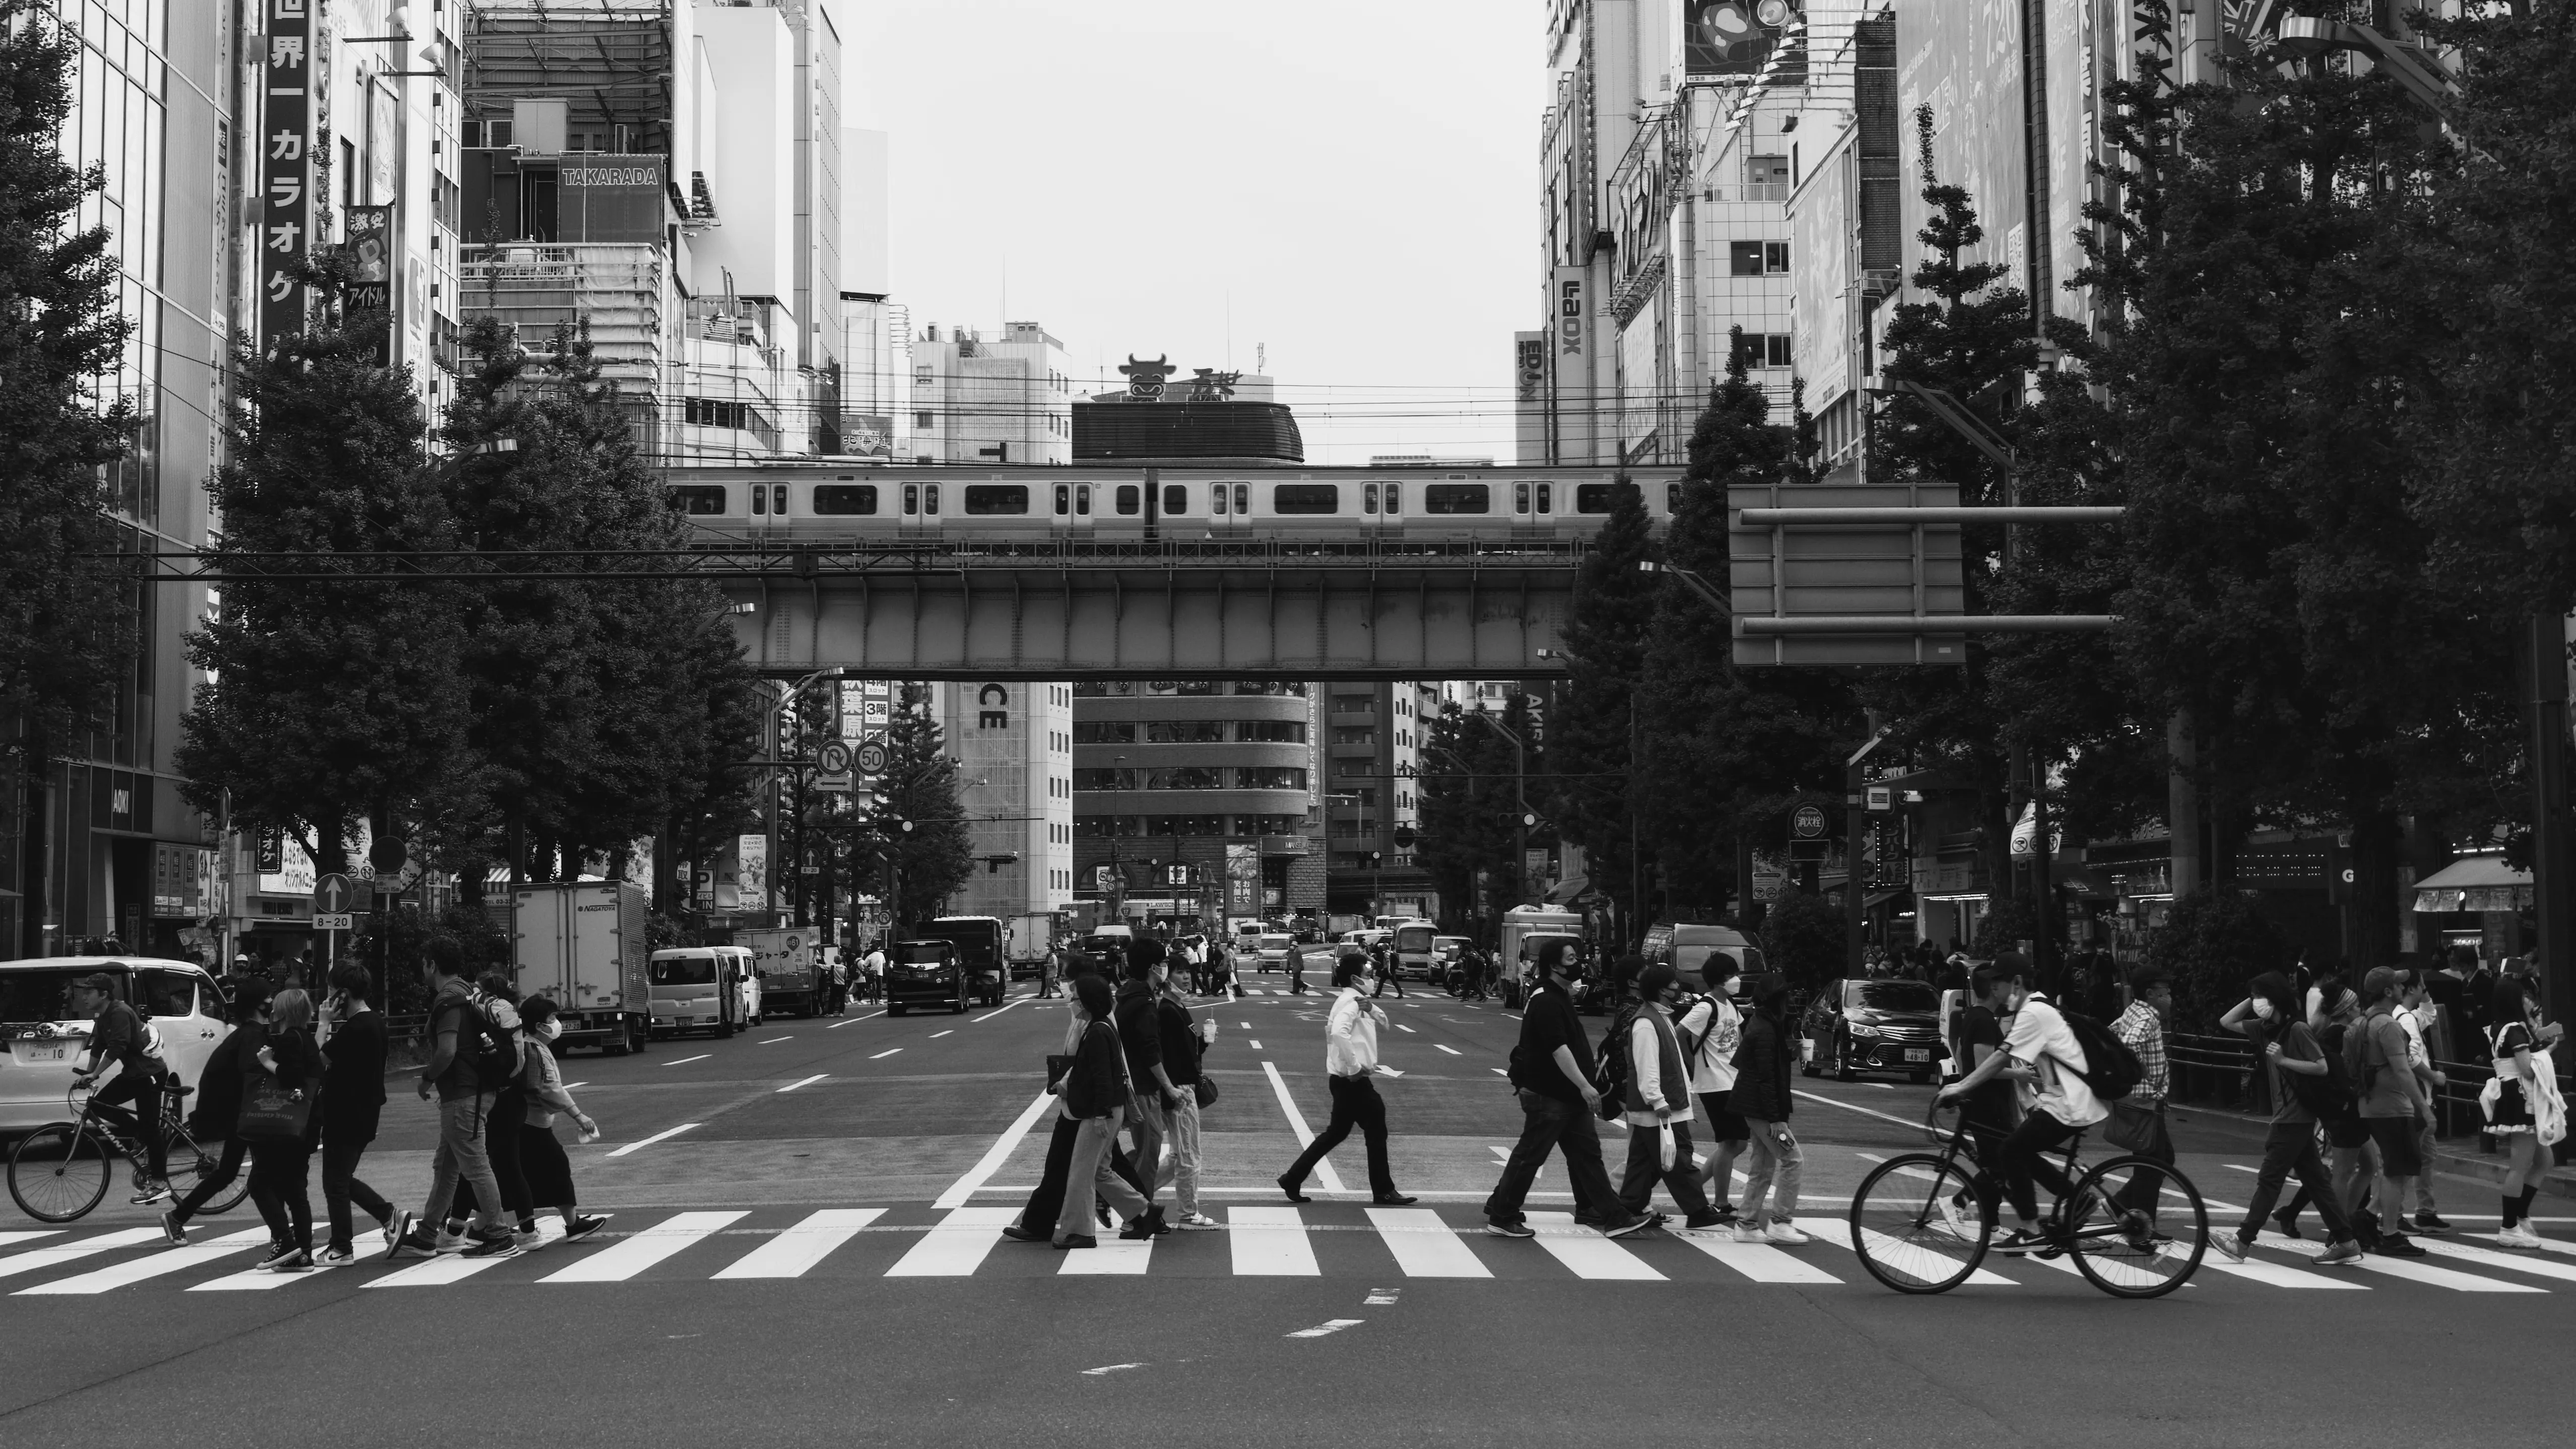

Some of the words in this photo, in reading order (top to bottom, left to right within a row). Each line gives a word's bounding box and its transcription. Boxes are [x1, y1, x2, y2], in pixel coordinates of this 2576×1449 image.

[562, 168, 658, 185] TAKARADA
[349, 210, 386, 231] 激安
[348, 285, 386, 307] アイドル
[1518, 340, 1542, 401] EDION
[842, 435, 887, 449] 北海道
[866, 703, 887, 716] 3階
[979, 683, 1007, 729] CE
[862, 751, 881, 766] 50
[113, 789, 129, 814] AOKI
[1797, 816, 1821, 827] 消火栓
[678, 870, 688, 880] 取
[697, 872, 709, 889] P
[2341, 869, 2354, 883] G
[1242, 880, 1250, 903] お肉で
[702, 901, 712, 909] IN
[318, 917, 348, 927] 8-20
[755, 950, 789, 960] ジャータ
[98, 1123, 128, 1153] GIANT
